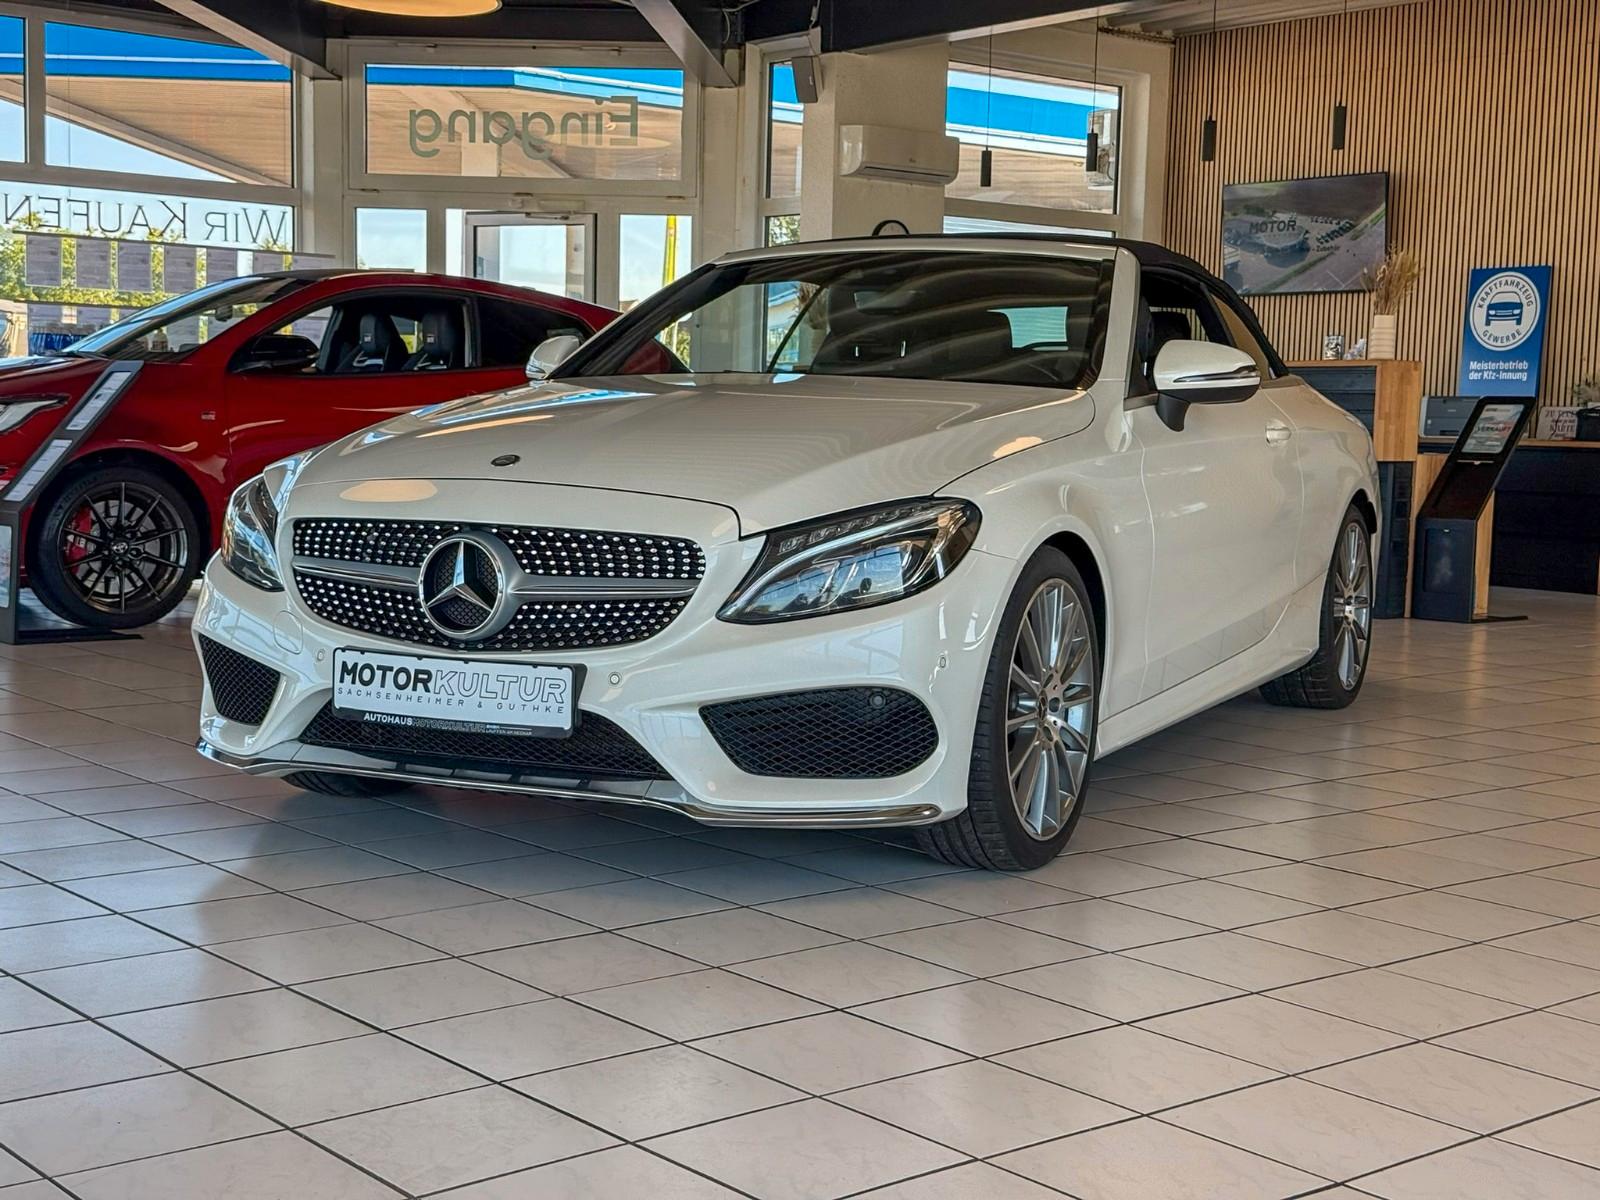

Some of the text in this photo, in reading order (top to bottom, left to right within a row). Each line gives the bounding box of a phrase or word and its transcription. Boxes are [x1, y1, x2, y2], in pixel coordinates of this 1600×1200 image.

[1249, 220, 1297, 233] MOTOR
[1478, 280, 1533, 309] KRAFTFAHRZEUG
[1482, 329, 1522, 343] GEWERBE
[1469, 361, 1528, 370] Meisterbetrieb
[1468, 371, 1527, 381] der Kfz-Innung
[338, 687, 465, 708] SACHSENHEIMER
[496, 702, 564, 714] GUTHKE
